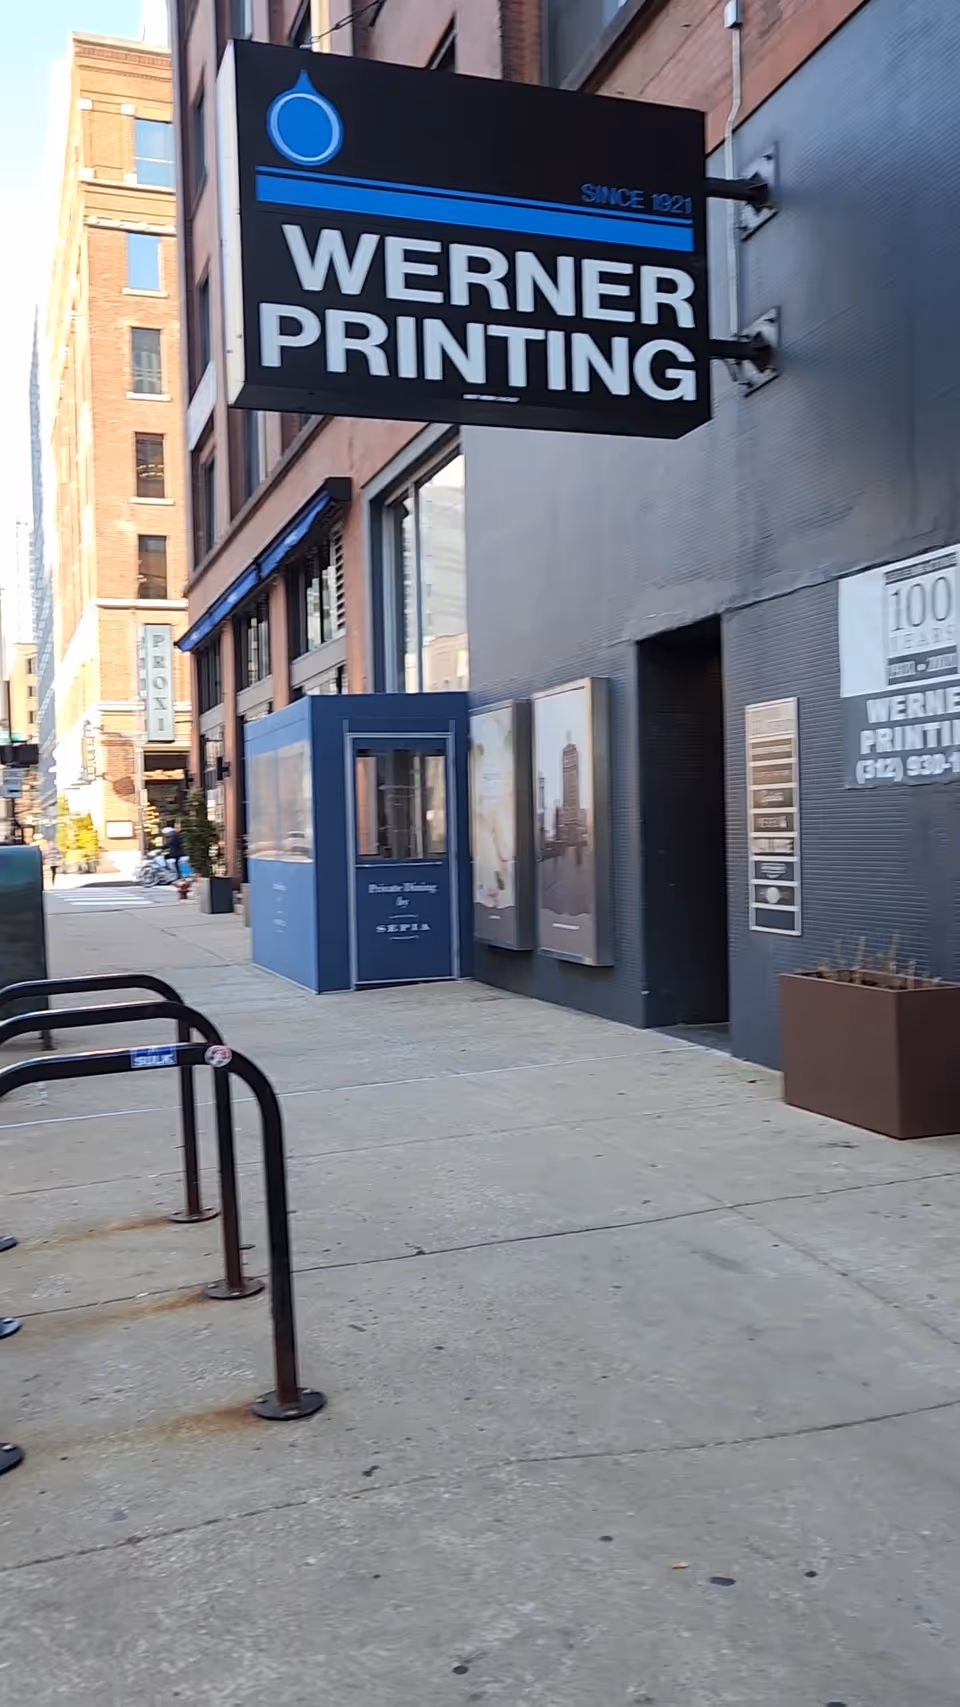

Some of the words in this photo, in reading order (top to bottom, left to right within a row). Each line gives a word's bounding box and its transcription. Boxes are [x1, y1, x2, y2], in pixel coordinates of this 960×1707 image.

[580, 183, 645, 209] SINCE
[650, 192, 692, 215] 1921
[281, 223, 696, 329] WERNER
[258, 301, 698, 402] PRINTING
[889, 576, 952, 632] 100
[856, 757, 903, 785] (312)
[395, 896, 410, 909] by
[375, 923, 431, 933] SEPIA
